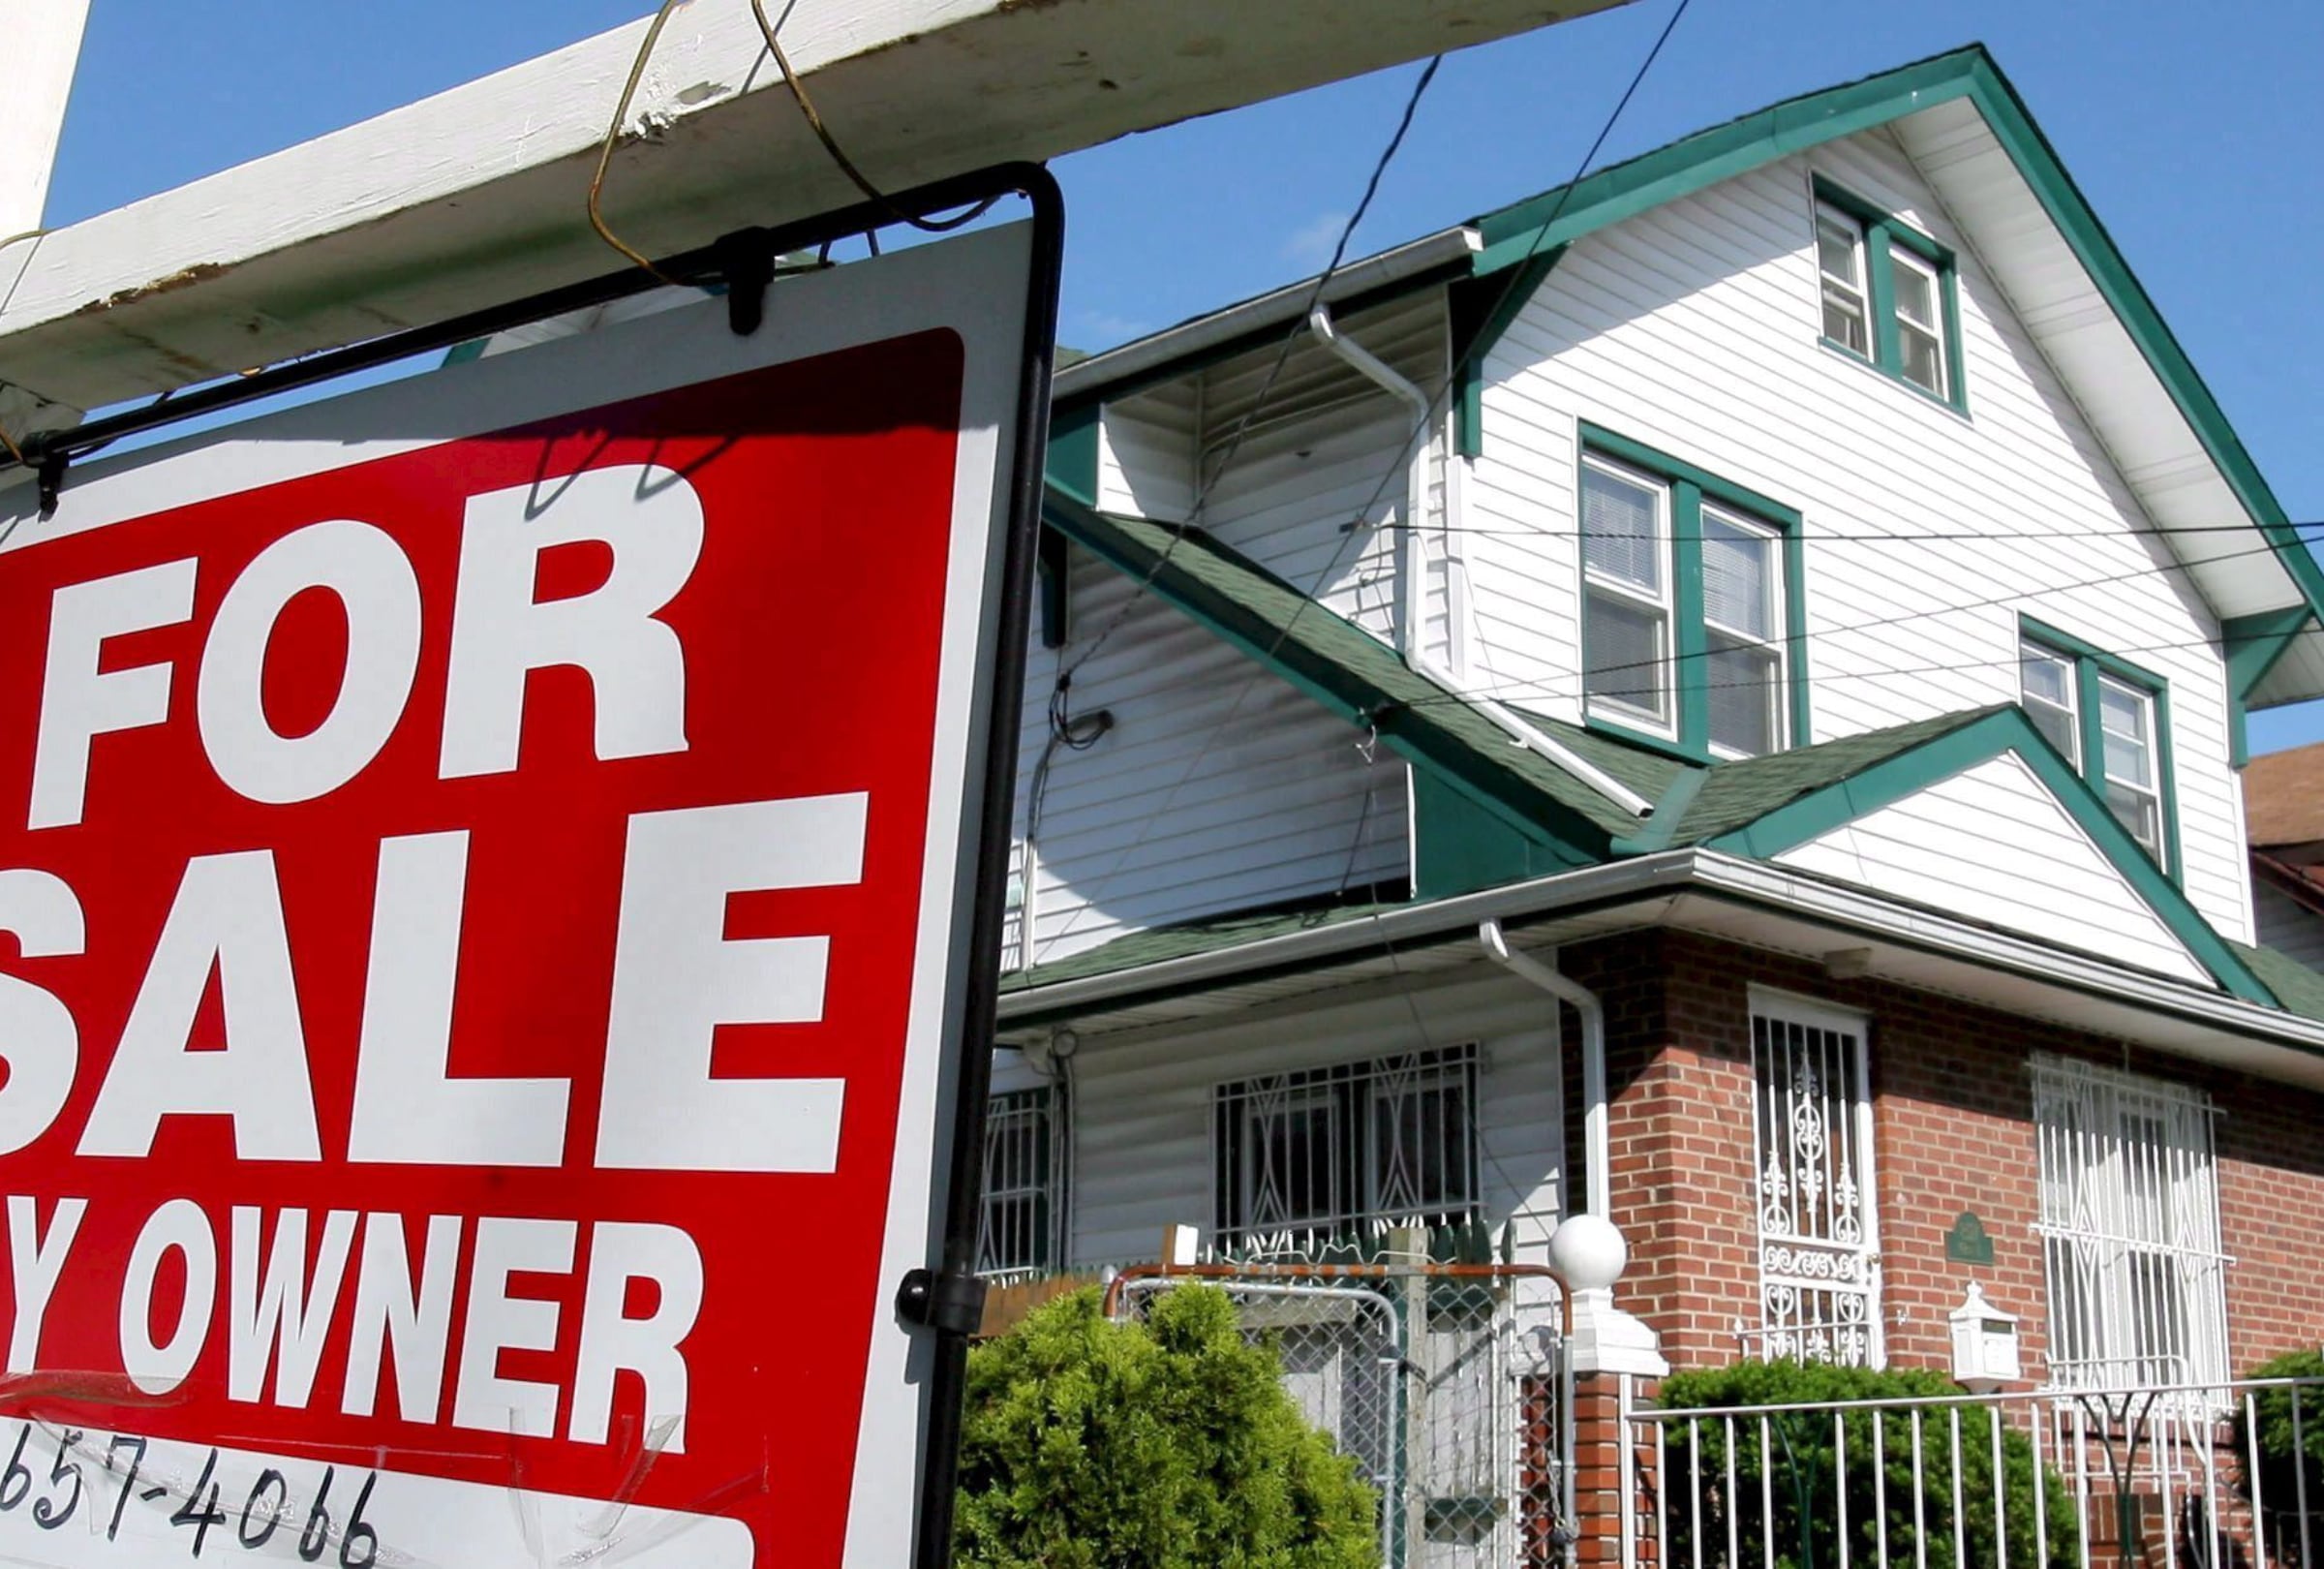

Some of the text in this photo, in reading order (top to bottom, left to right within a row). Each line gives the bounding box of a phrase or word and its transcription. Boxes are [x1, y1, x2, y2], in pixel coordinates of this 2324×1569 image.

[27, 463, 705, 831] FOR
[119, 1198, 704, 1455] OWNER
[0, 1423, 378, 1569] 657-4066
